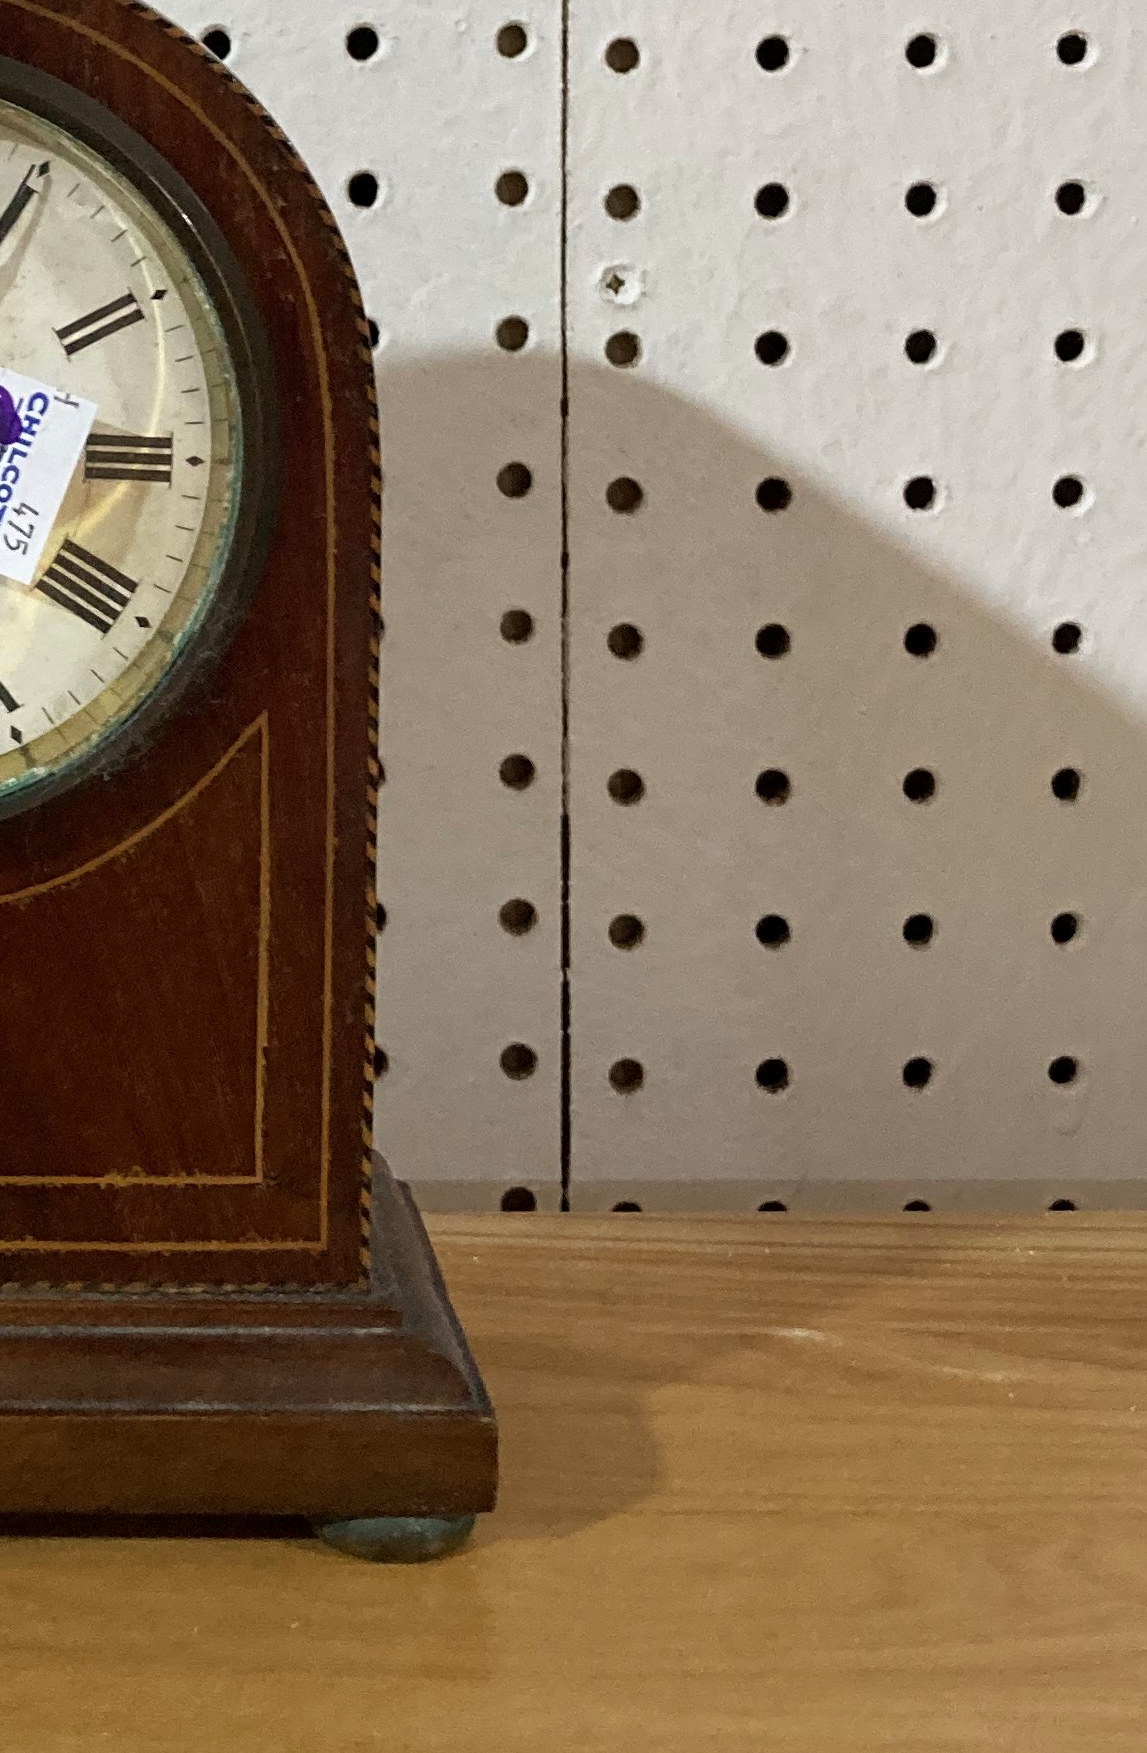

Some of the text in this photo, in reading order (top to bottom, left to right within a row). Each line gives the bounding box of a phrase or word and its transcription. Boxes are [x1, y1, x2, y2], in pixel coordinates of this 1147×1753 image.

[52, 286, 147, 361] II
[83, 431, 174, 490] III
[2, 500, 40, 557] 475
